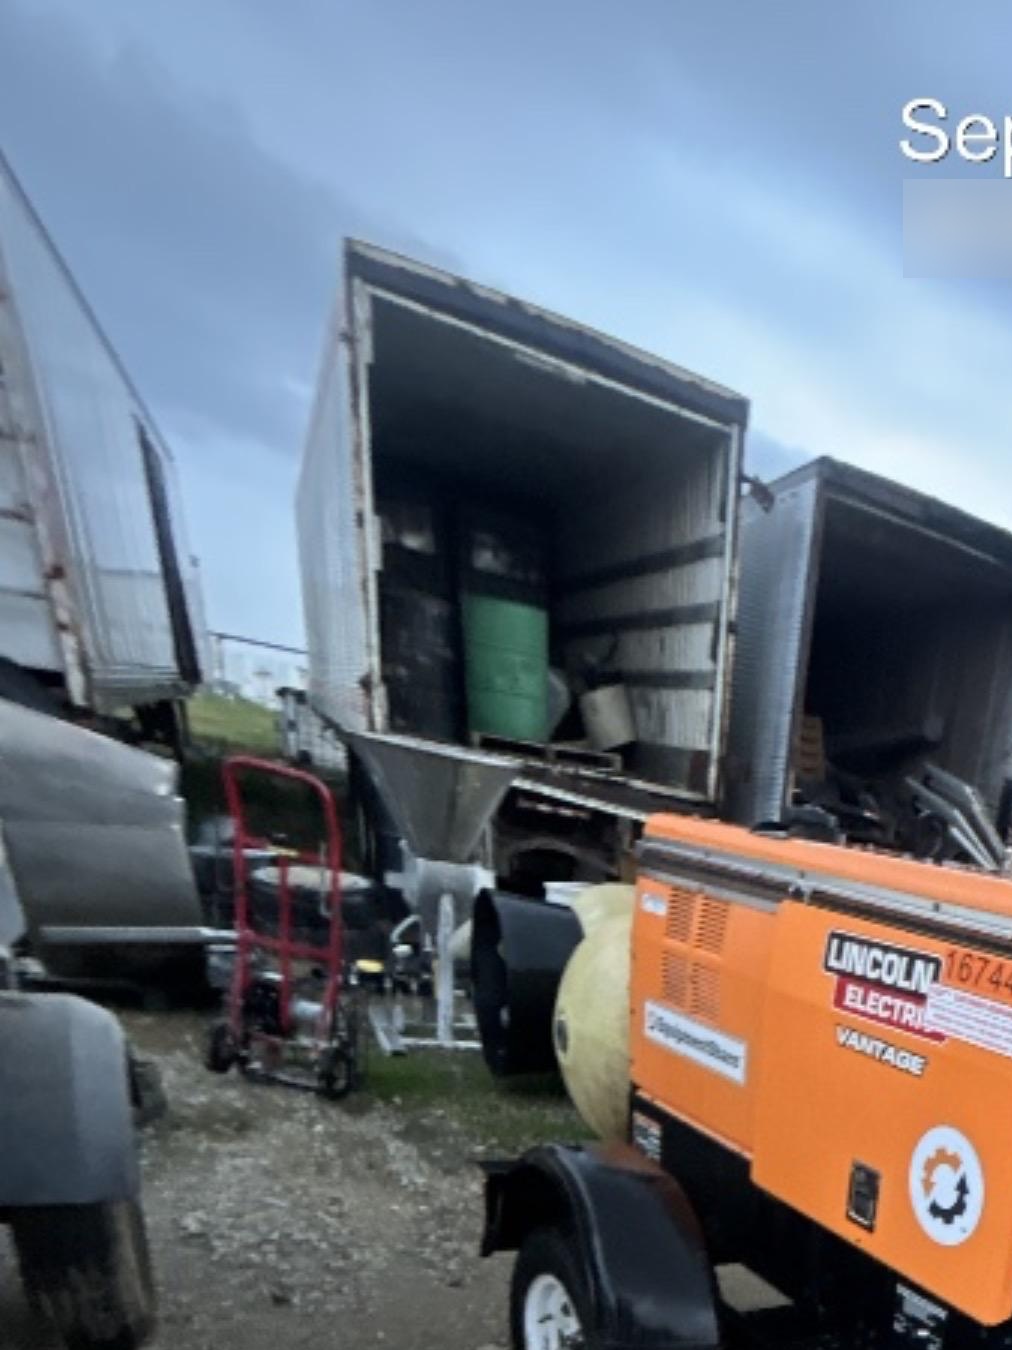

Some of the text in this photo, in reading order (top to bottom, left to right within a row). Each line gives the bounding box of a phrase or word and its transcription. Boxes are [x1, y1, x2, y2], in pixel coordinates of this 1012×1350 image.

[828, 937, 937, 993] LINCOLN
[843, 984, 930, 1030] ELECTRI
[837, 1026, 927, 1075] VANTAGE
